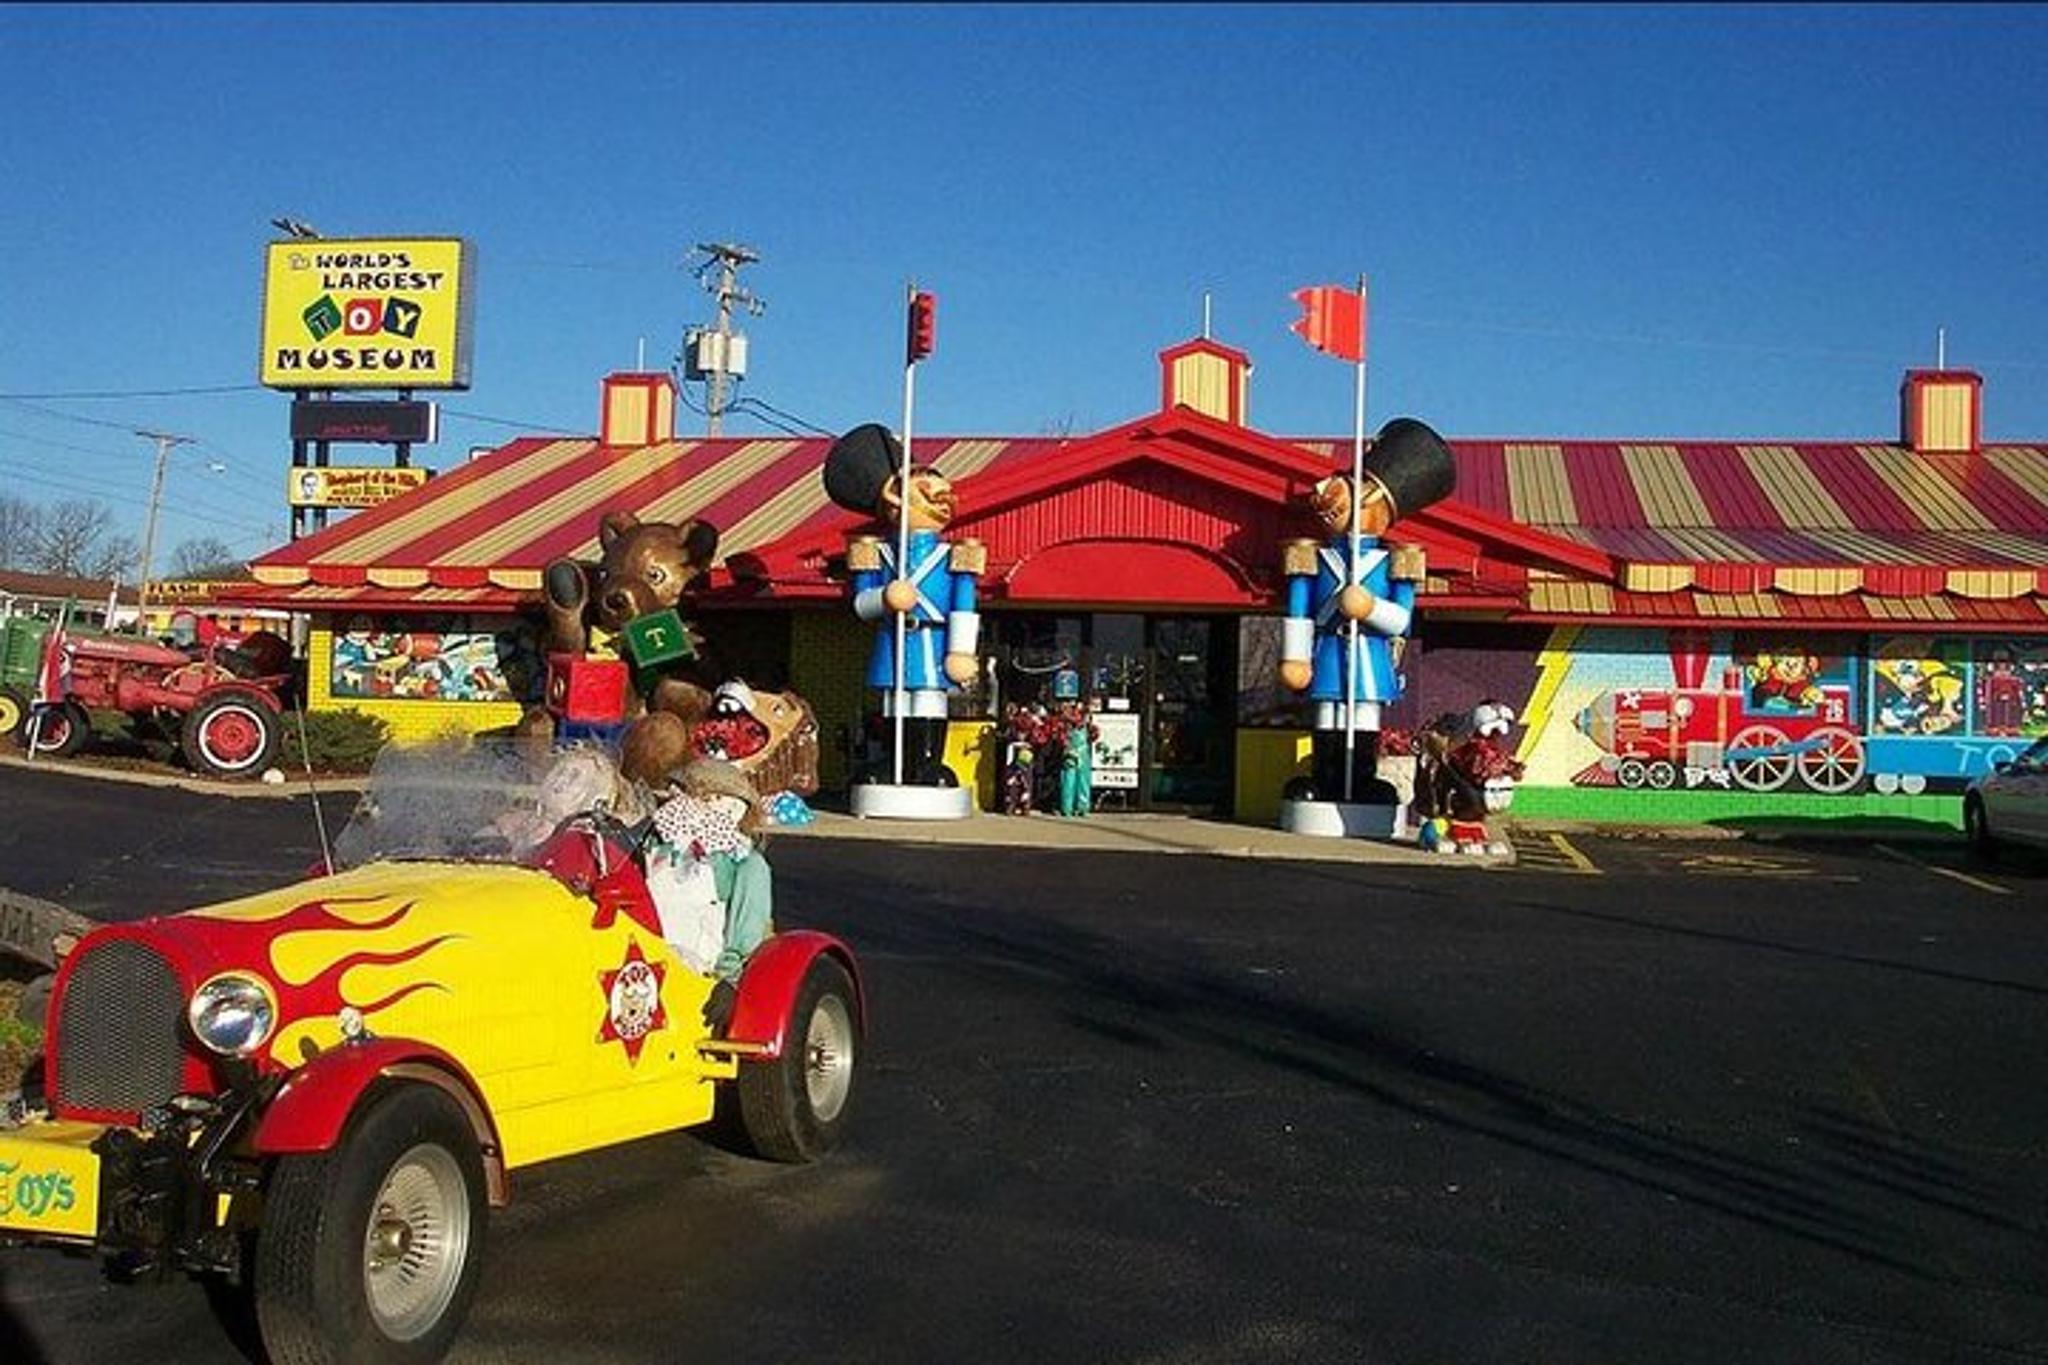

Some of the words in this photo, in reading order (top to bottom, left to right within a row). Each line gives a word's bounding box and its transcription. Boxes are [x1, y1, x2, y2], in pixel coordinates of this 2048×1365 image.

[316, 253, 411, 269] WORLD'S
[323, 272, 444, 290] LARGEST
[305, 303, 419, 336] TOY
[276, 349, 437, 370] MUSEUM
[645, 627, 666, 648] T
